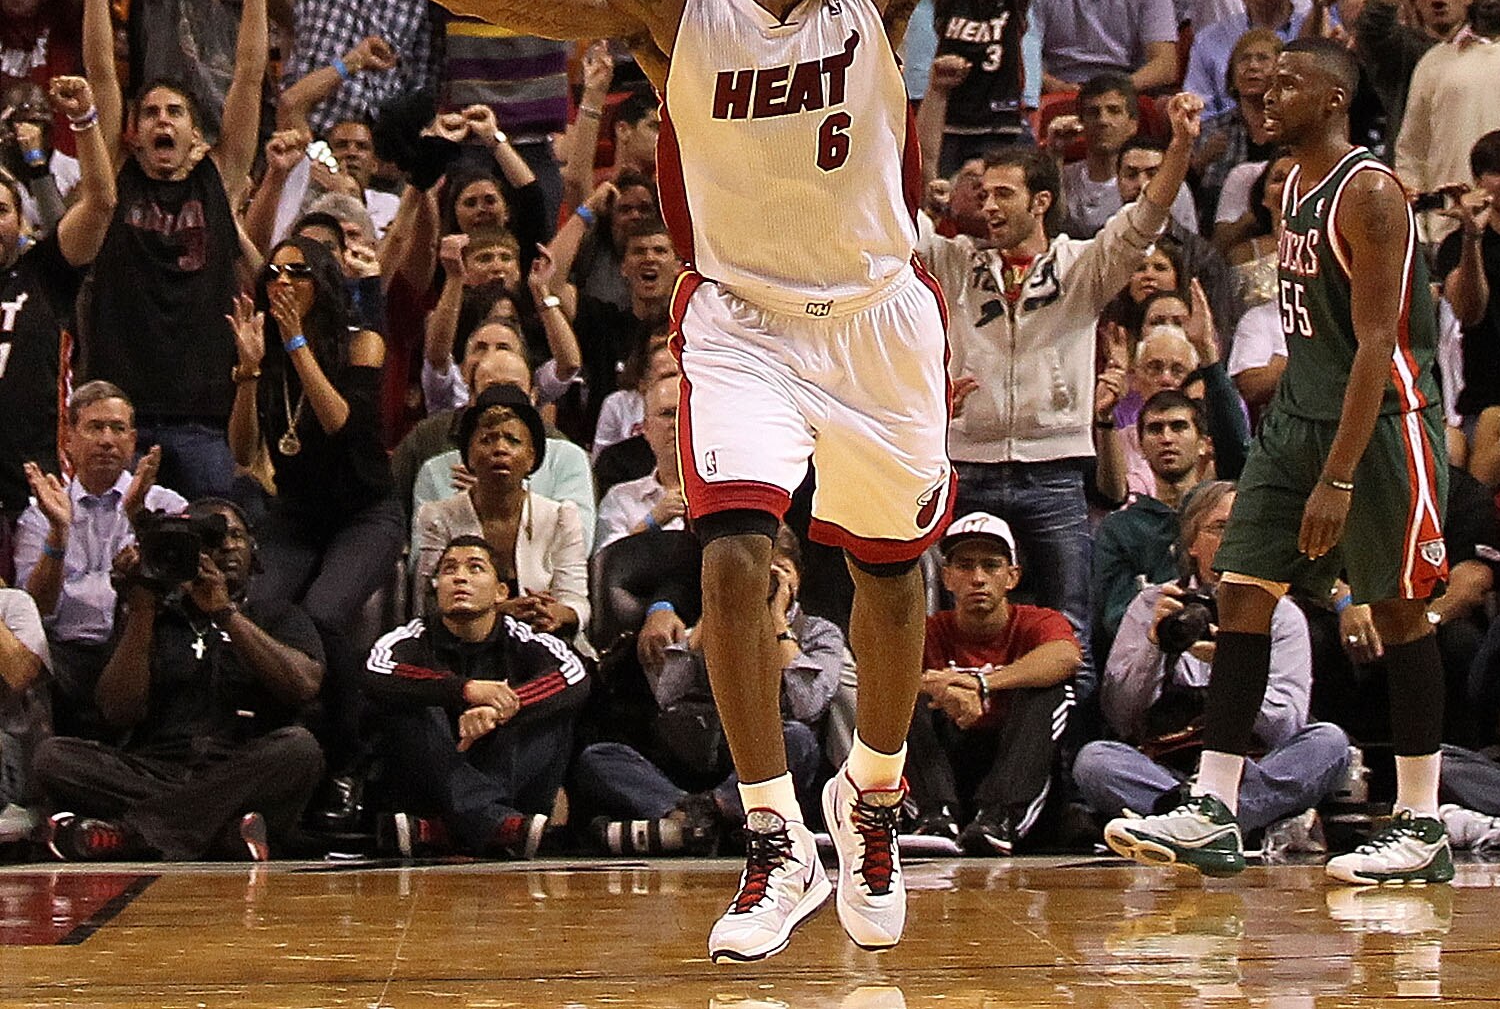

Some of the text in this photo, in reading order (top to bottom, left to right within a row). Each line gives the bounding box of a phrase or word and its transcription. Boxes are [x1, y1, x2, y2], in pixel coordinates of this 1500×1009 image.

[944, 11, 1010, 44] HEAT
[982, 43, 1004, 72] 3
[711, 28, 861, 121] HEAT
[815, 109, 853, 175] 6
[1280, 278, 1314, 339] 55
